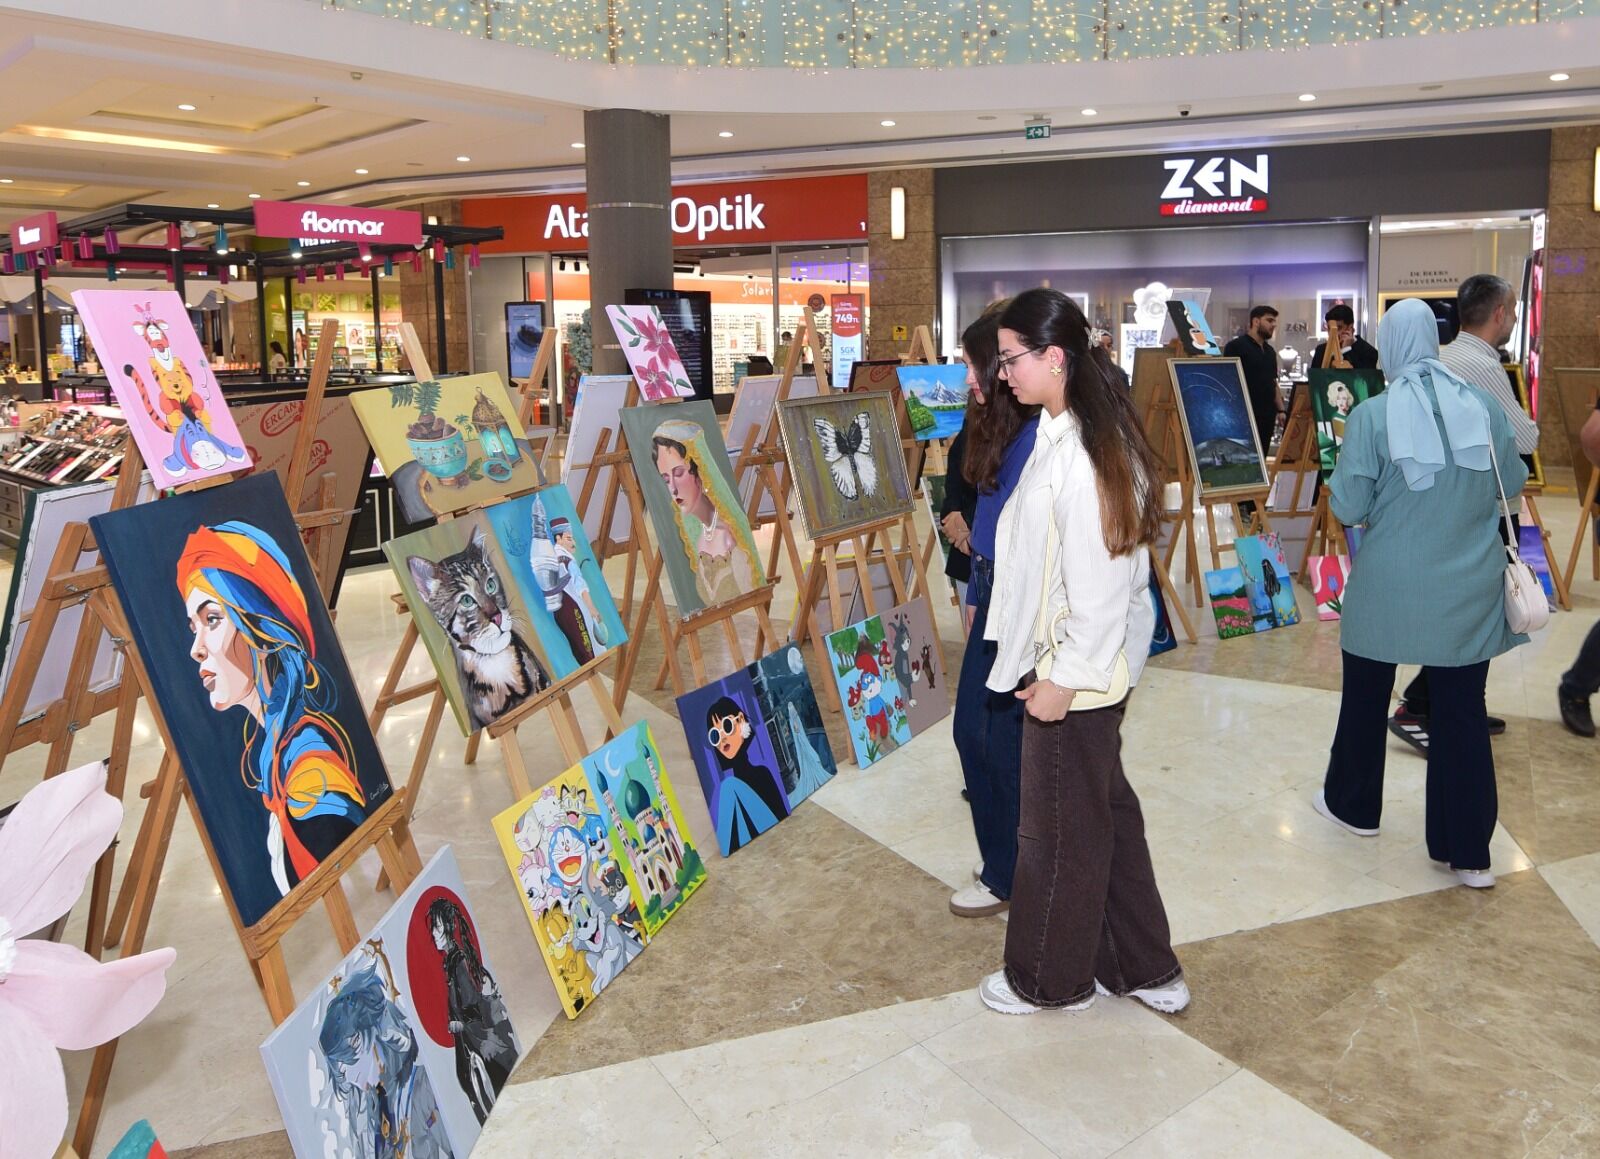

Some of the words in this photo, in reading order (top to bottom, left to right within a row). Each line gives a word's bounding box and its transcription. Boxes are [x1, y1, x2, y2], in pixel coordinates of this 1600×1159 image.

[1160, 154, 1269, 199] ZEN
[671, 193, 765, 240] Optik
[1173, 196, 1254, 215] diamond
[301, 211, 385, 236] flormar
[264, 402, 297, 430] ERCAN
